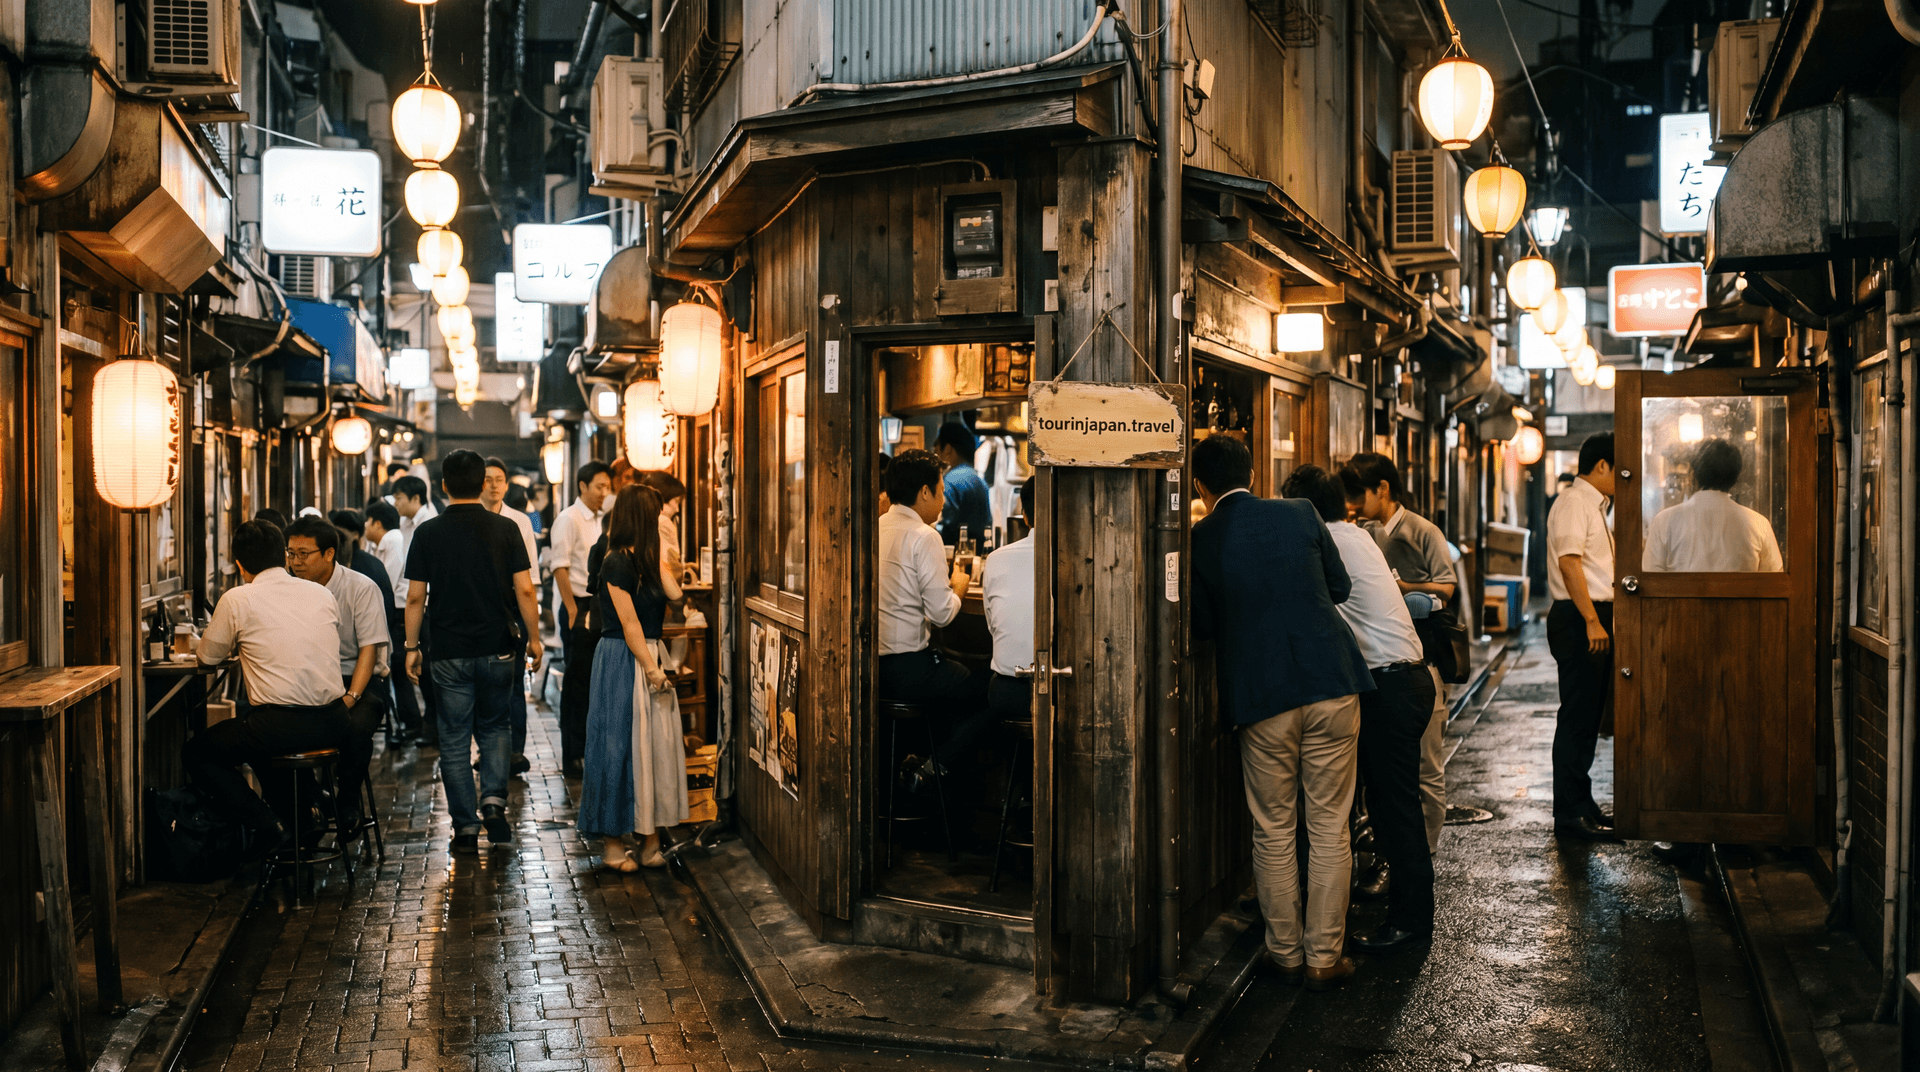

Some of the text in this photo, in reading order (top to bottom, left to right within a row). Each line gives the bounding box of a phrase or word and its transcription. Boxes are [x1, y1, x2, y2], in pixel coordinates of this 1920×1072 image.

[335, 187, 366, 216] 花
[1679, 161, 1703, 218] たち
[1038, 416, 1175, 435] tourinjapan.travel
